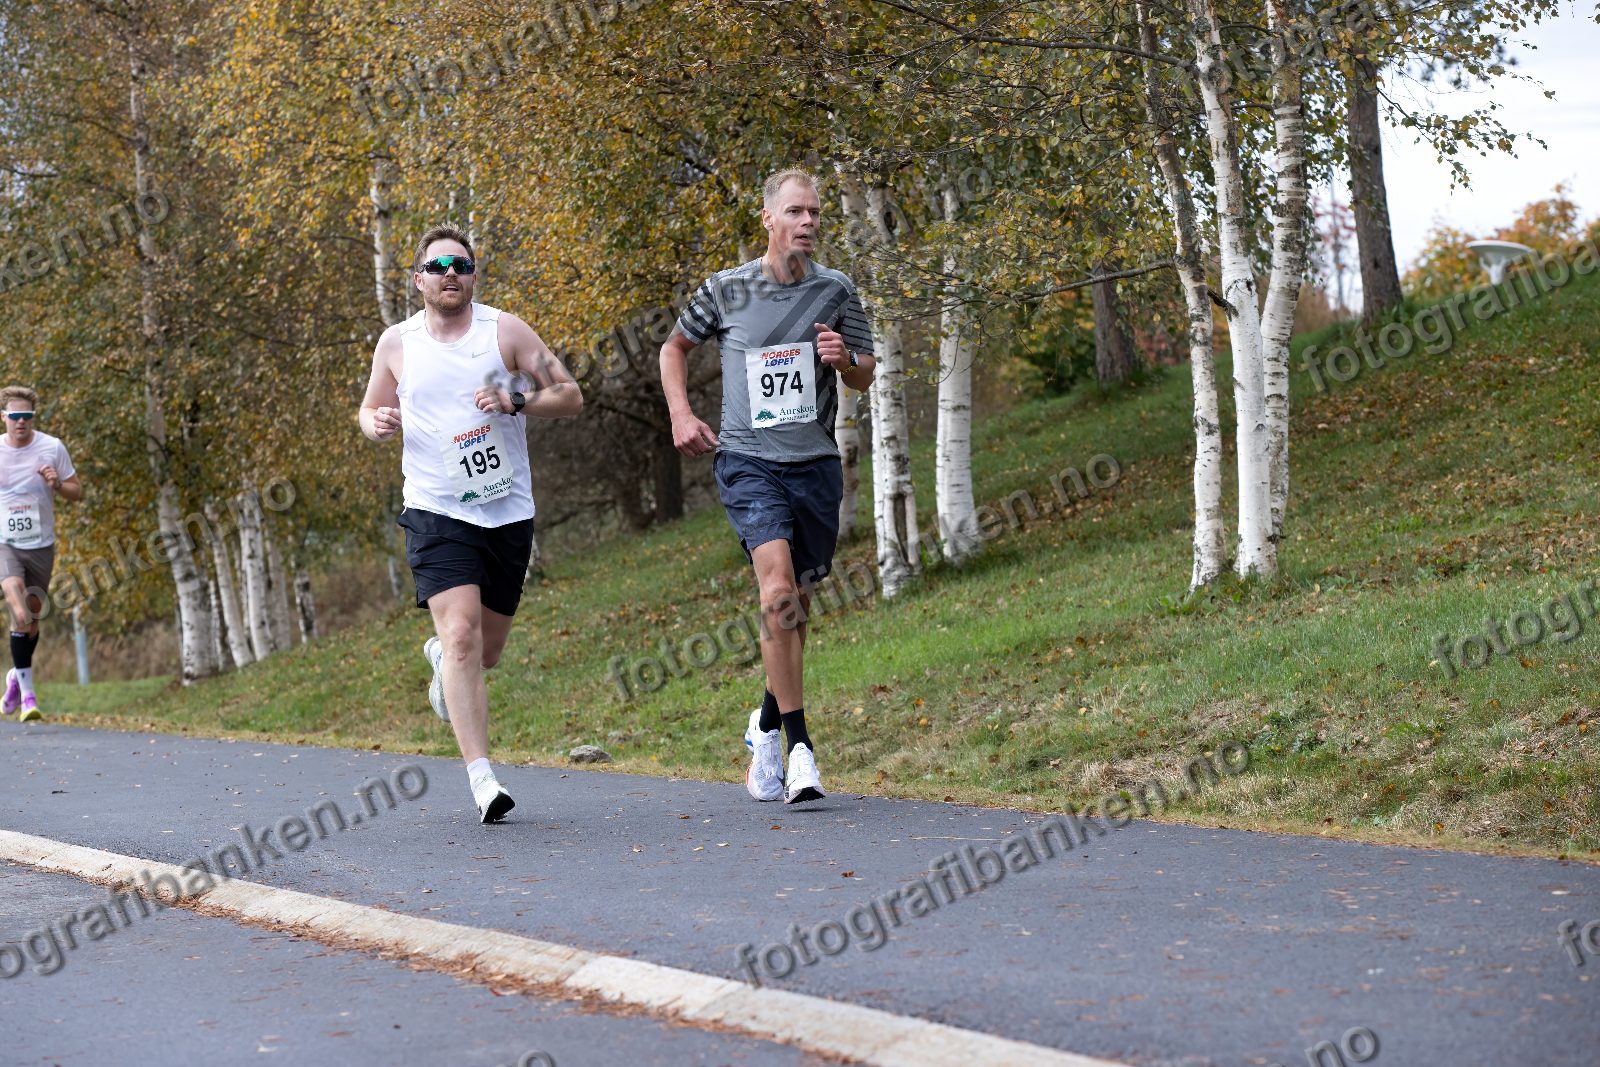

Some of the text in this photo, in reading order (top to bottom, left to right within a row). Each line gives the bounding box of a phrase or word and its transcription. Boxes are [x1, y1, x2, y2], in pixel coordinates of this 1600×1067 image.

[761, 348, 801, 360] NORGES
[765, 356, 796, 368] LØPET
[760, 370, 804, 398] 974
[779, 404, 815, 416] Aurskog
[453, 424, 492, 444] NORGES
[459, 433, 487, 450] LØPET
[459, 445, 501, 479] 195
[8, 517, 33, 532] 953
